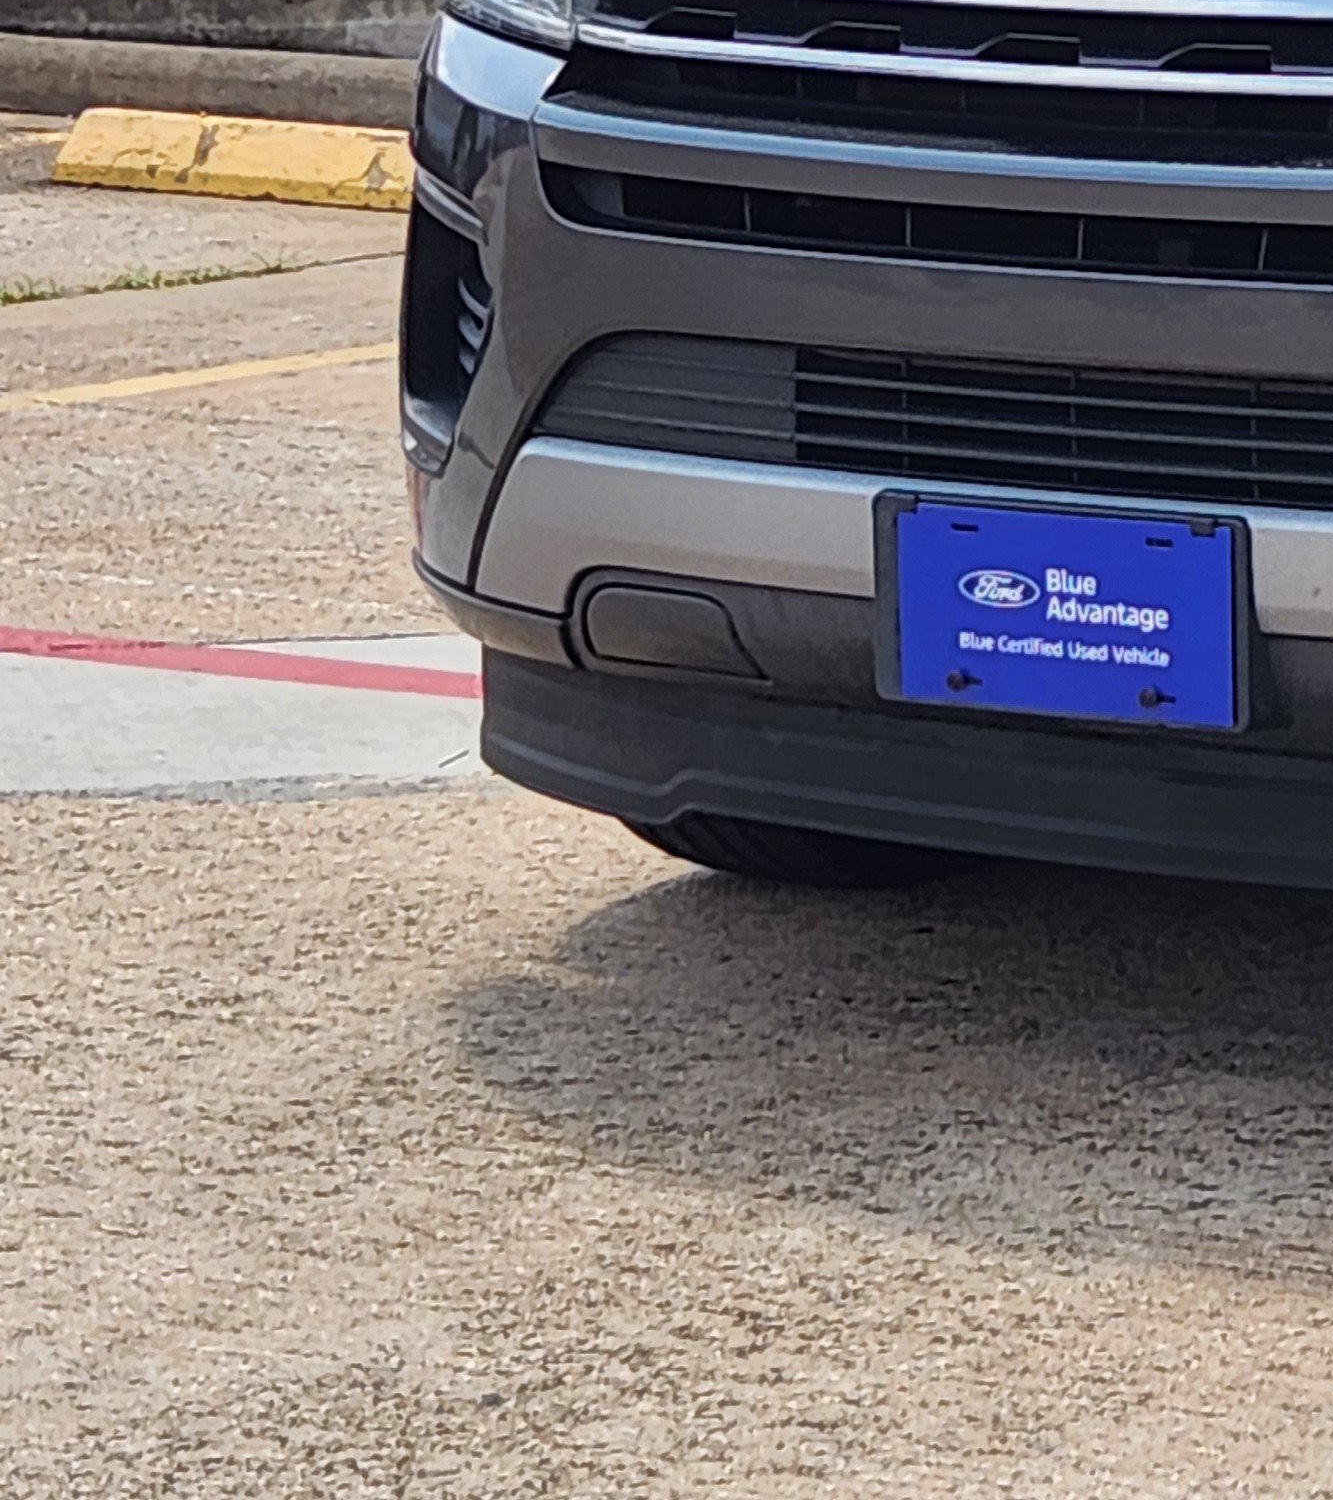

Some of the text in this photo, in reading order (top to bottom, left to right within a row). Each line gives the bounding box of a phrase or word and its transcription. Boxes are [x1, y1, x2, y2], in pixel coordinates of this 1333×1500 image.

[973, 573, 1024, 602] Ford
[1046, 568, 1096, 596] Blue
[1046, 596, 1169, 632] Advantage
[959, 632, 1170, 668] Blue Certified Used Vehicle
